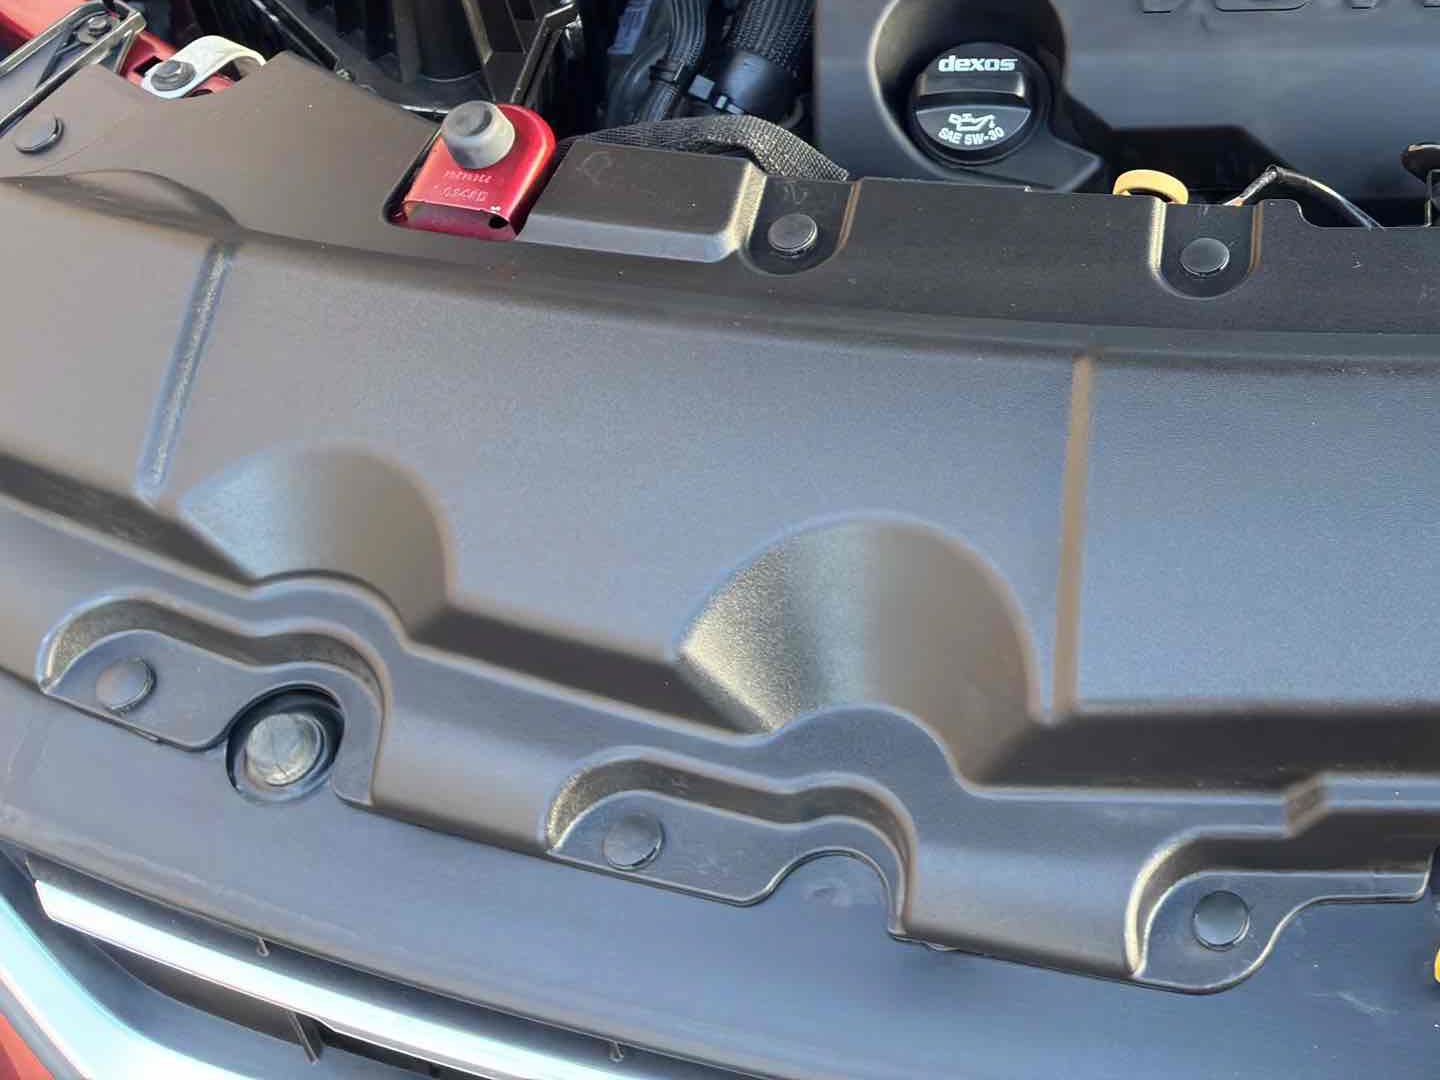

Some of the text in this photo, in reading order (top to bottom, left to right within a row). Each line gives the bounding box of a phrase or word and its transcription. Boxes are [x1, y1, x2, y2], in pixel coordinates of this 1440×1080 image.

[938, 55, 1019, 72] dexos
[938, 126, 1005, 145] SAE 5W-30
